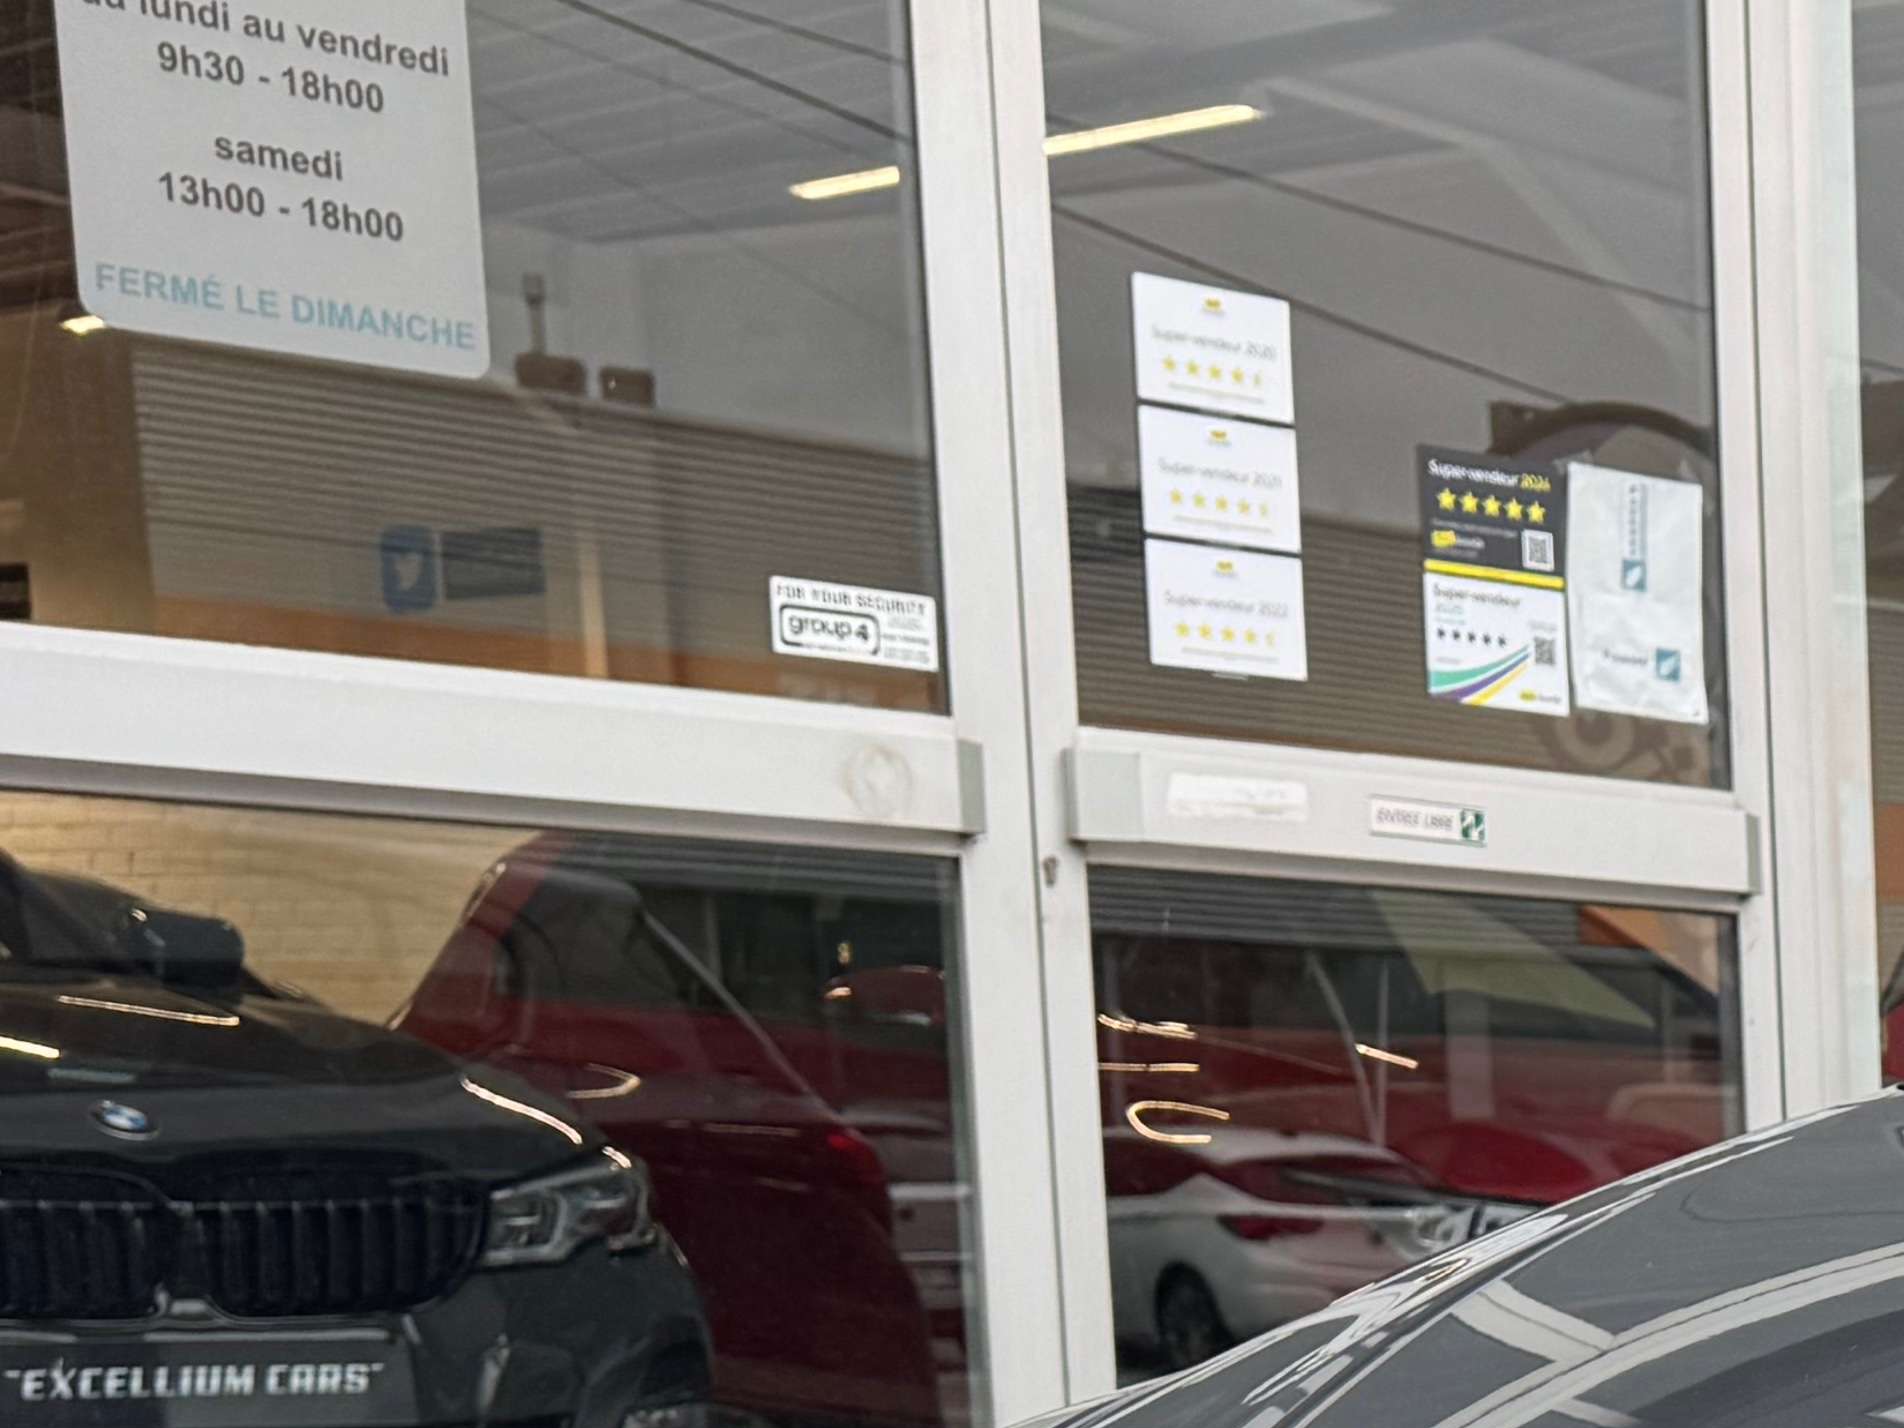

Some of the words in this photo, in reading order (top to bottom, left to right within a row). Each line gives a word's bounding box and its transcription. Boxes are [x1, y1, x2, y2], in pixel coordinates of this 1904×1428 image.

[243, 14, 285, 42] au
[297, 24, 450, 76] vendredi
[157, 41, 245, 86] 9h30
[282, 67, 385, 113] 18h00
[214, 136, 343, 180] samedi
[158, 171, 265, 218] 13h00
[302, 197, 404, 241] 18h00
[95, 263, 225, 311] FERMÉ
[235, 285, 280, 319] LE
[291, 295, 476, 350] DIMANCHE
[789, 614, 853, 639] group
[856, 593, 926, 616] SECURITY
[21, 1362, 255, 1401] EXCELLIUM
[266, 1363, 370, 1395] CARS
